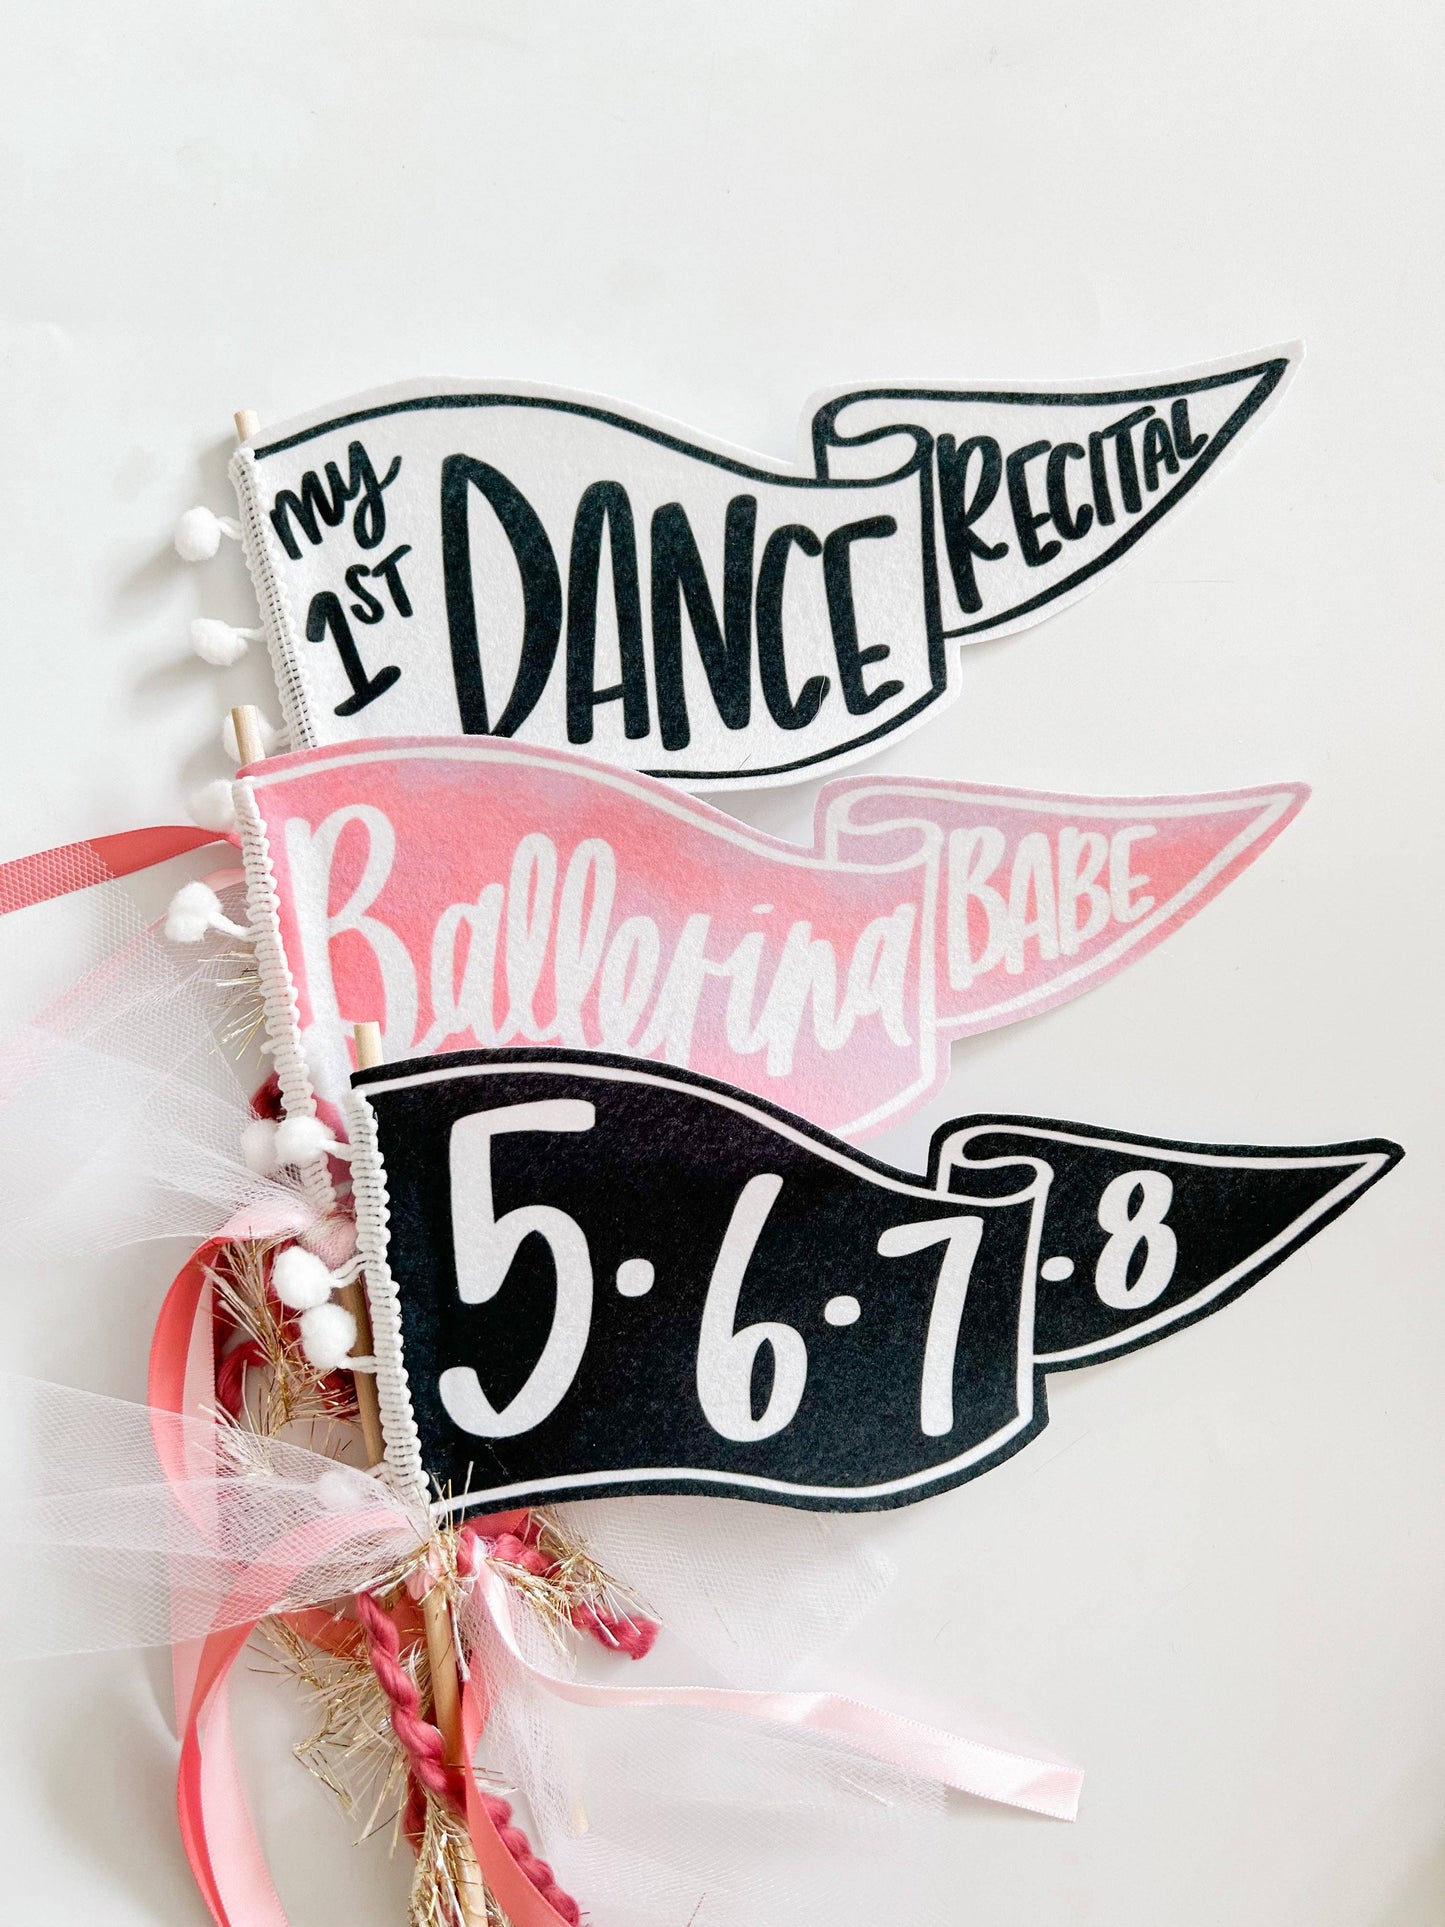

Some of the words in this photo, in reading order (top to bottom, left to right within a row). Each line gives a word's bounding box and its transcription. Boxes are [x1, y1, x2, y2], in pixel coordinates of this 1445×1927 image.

[305, 544, 412, 716] 1ST
[440, 452, 905, 751] DANCE
[936, 399, 1208, 614] RECITAL
[284, 803, 915, 1125] Ballerina
[947, 825, 1158, 990] BABE
